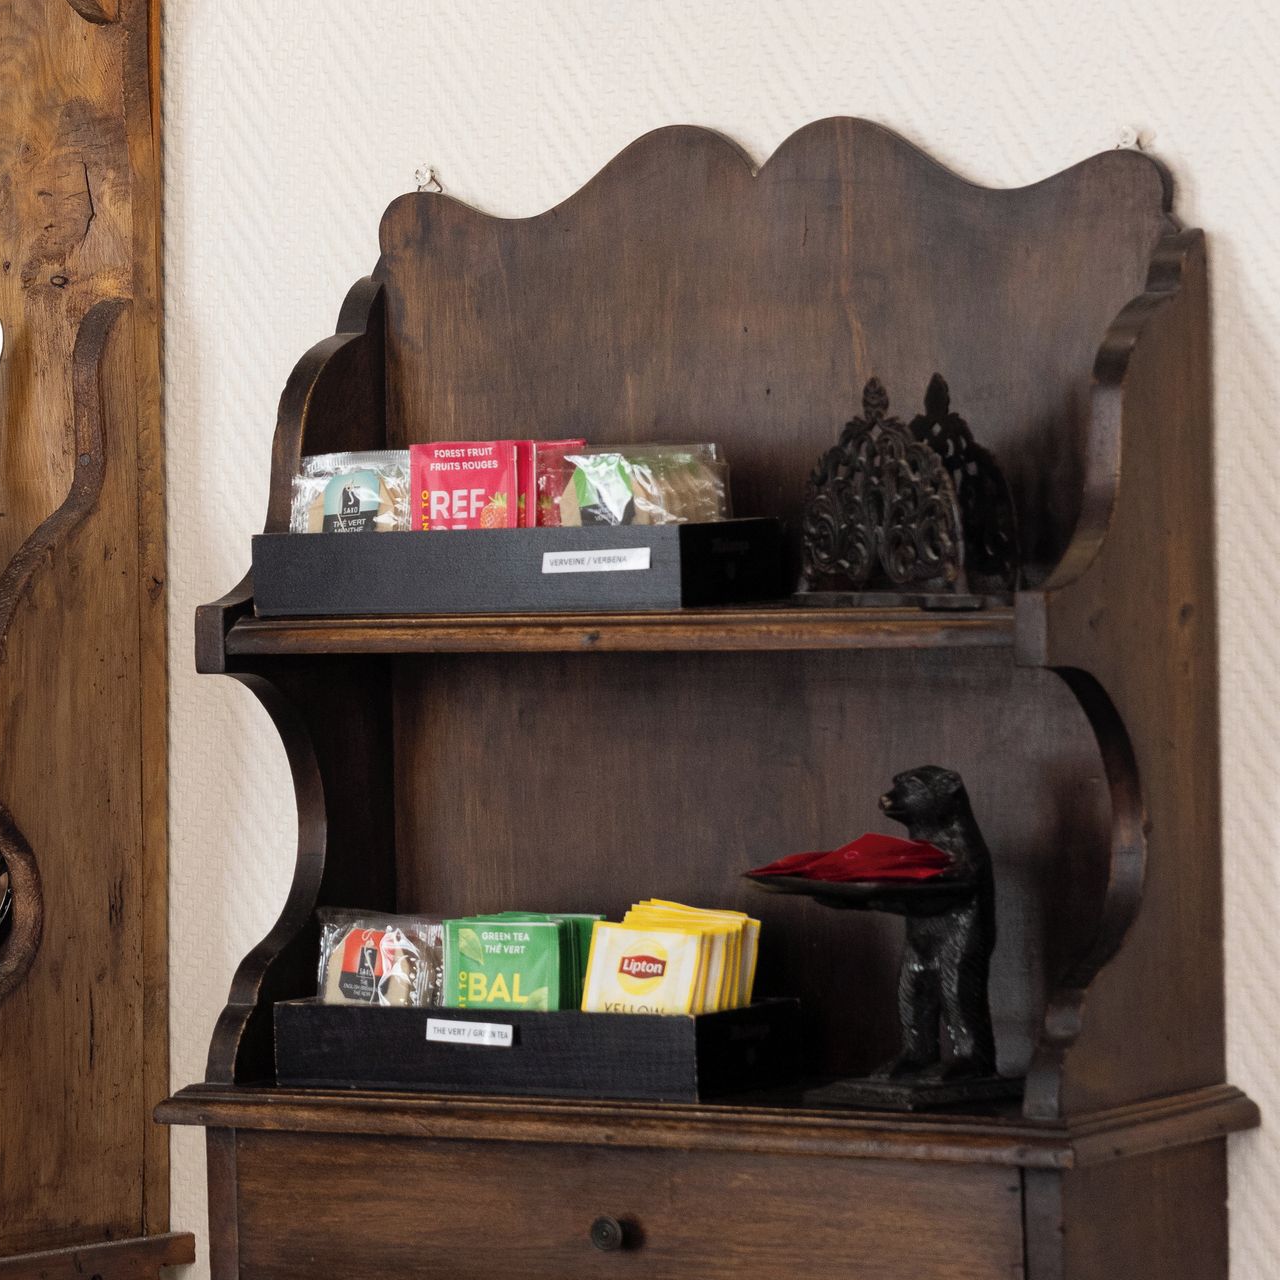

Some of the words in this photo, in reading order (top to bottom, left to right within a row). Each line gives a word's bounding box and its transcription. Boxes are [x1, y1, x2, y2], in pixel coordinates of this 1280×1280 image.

[434, 449, 465, 458] FOREST
[467, 447, 493, 457] FRUIT
[430, 462, 461, 471] FRUITS
[462, 460, 499, 470] ROUGES
[430, 488, 486, 520] REF
[347, 518, 366, 527] VERT
[549, 557, 586, 567] VERVEINE
[592, 554, 628, 565] VERBENA
[481, 931, 511, 941] GREEN
[512, 931, 530, 941] TEA
[484, 943, 502, 954] THÉ
[503, 945, 526, 954] VERT
[622, 958, 663, 974] Lipton
[468, 972, 529, 1003] BAL
[447, 1028, 466, 1036] VERT
[496, 1031, 508, 1039] TEA
